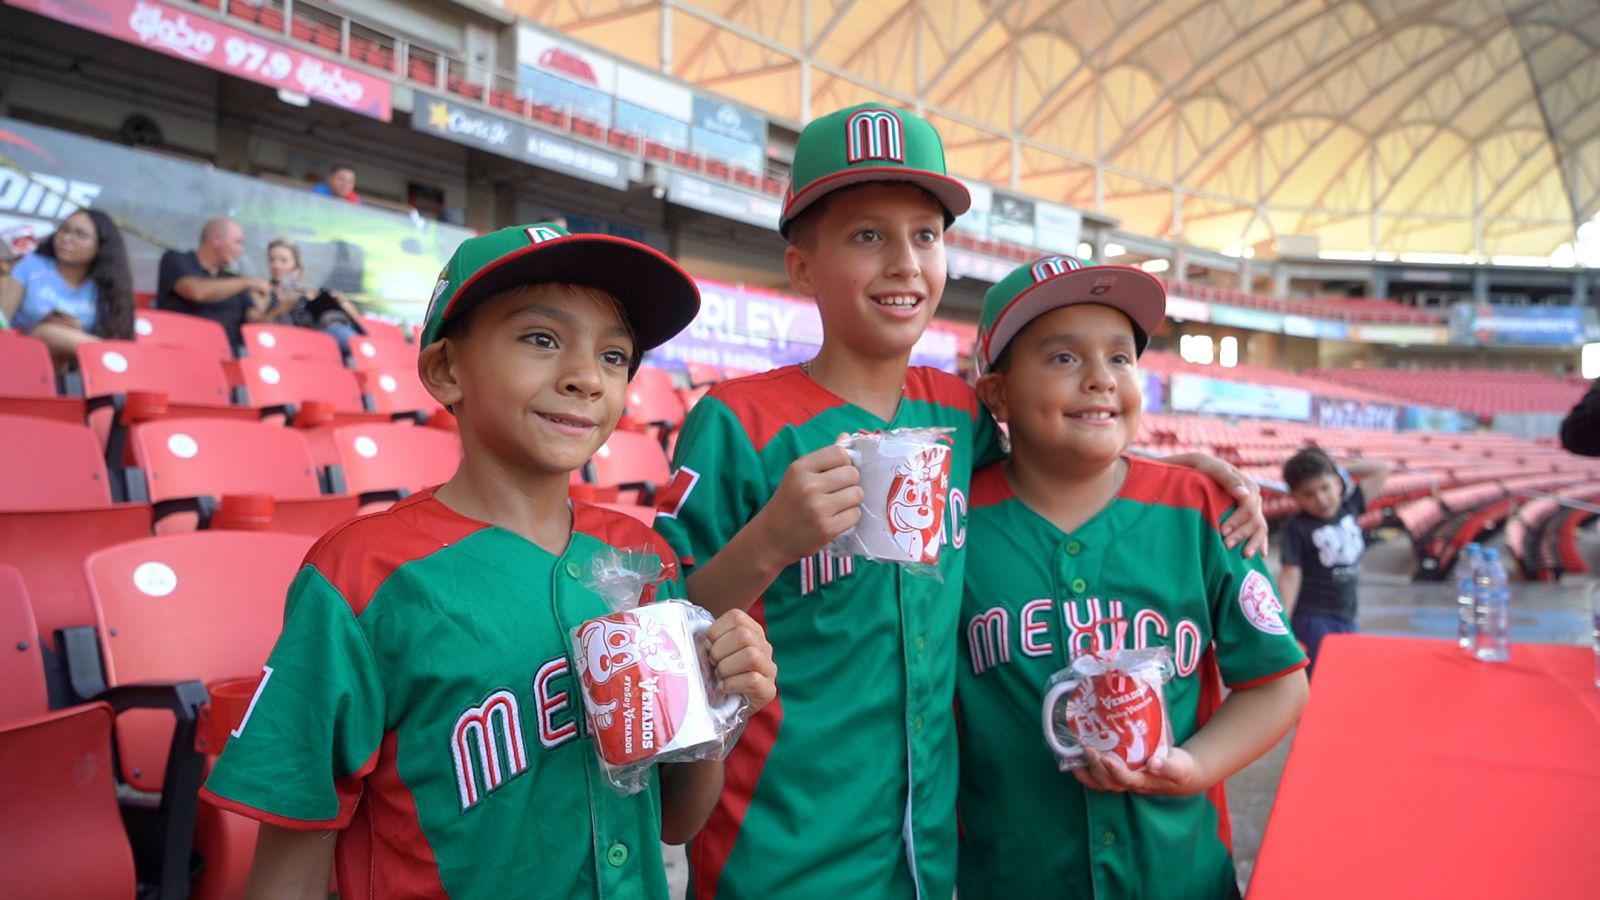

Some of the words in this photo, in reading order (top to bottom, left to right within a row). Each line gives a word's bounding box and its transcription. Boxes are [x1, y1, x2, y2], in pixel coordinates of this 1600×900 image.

[224, 37, 292, 80] 97.9
[846, 108, 905, 164] M
[966, 597, 1202, 677] MEXICO
[1099, 686, 1147, 710] VENADO
[450, 653, 582, 813] ME
